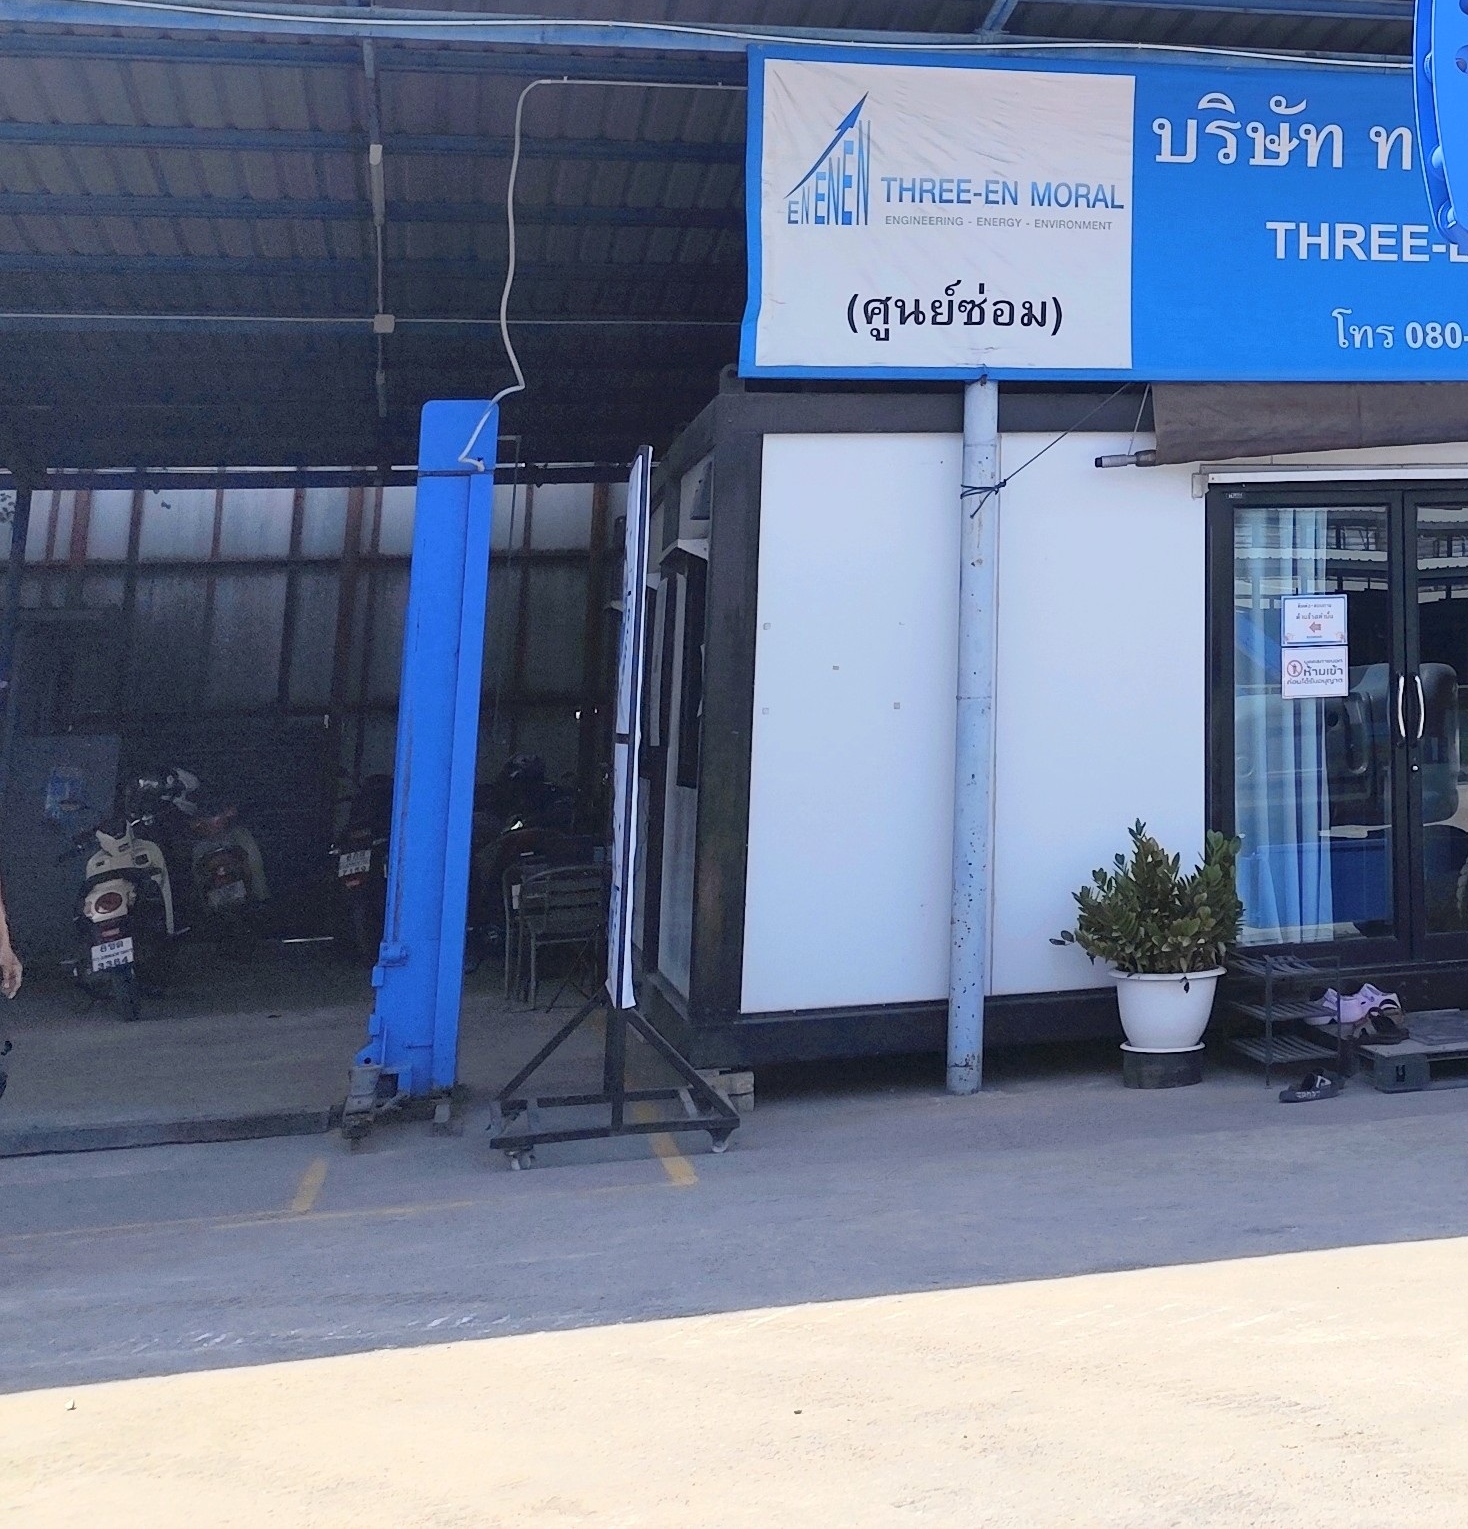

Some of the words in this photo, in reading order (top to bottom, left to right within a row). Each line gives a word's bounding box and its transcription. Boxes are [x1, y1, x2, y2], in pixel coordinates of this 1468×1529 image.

[1150, 91, 1345, 170] บริษัท
[879, 176, 1020, 207] THREE-EN
[1029, 180, 1126, 210] MORAL
[884, 215, 965, 227] ENGINEERING
[975, 216, 1023, 229] ENERGY
[1033, 218, 1114, 231] ENVIRONMENT
[846, 278, 1064, 343] (ศูนย์ซ่อม)
[1331, 307, 1396, 350] โทร
